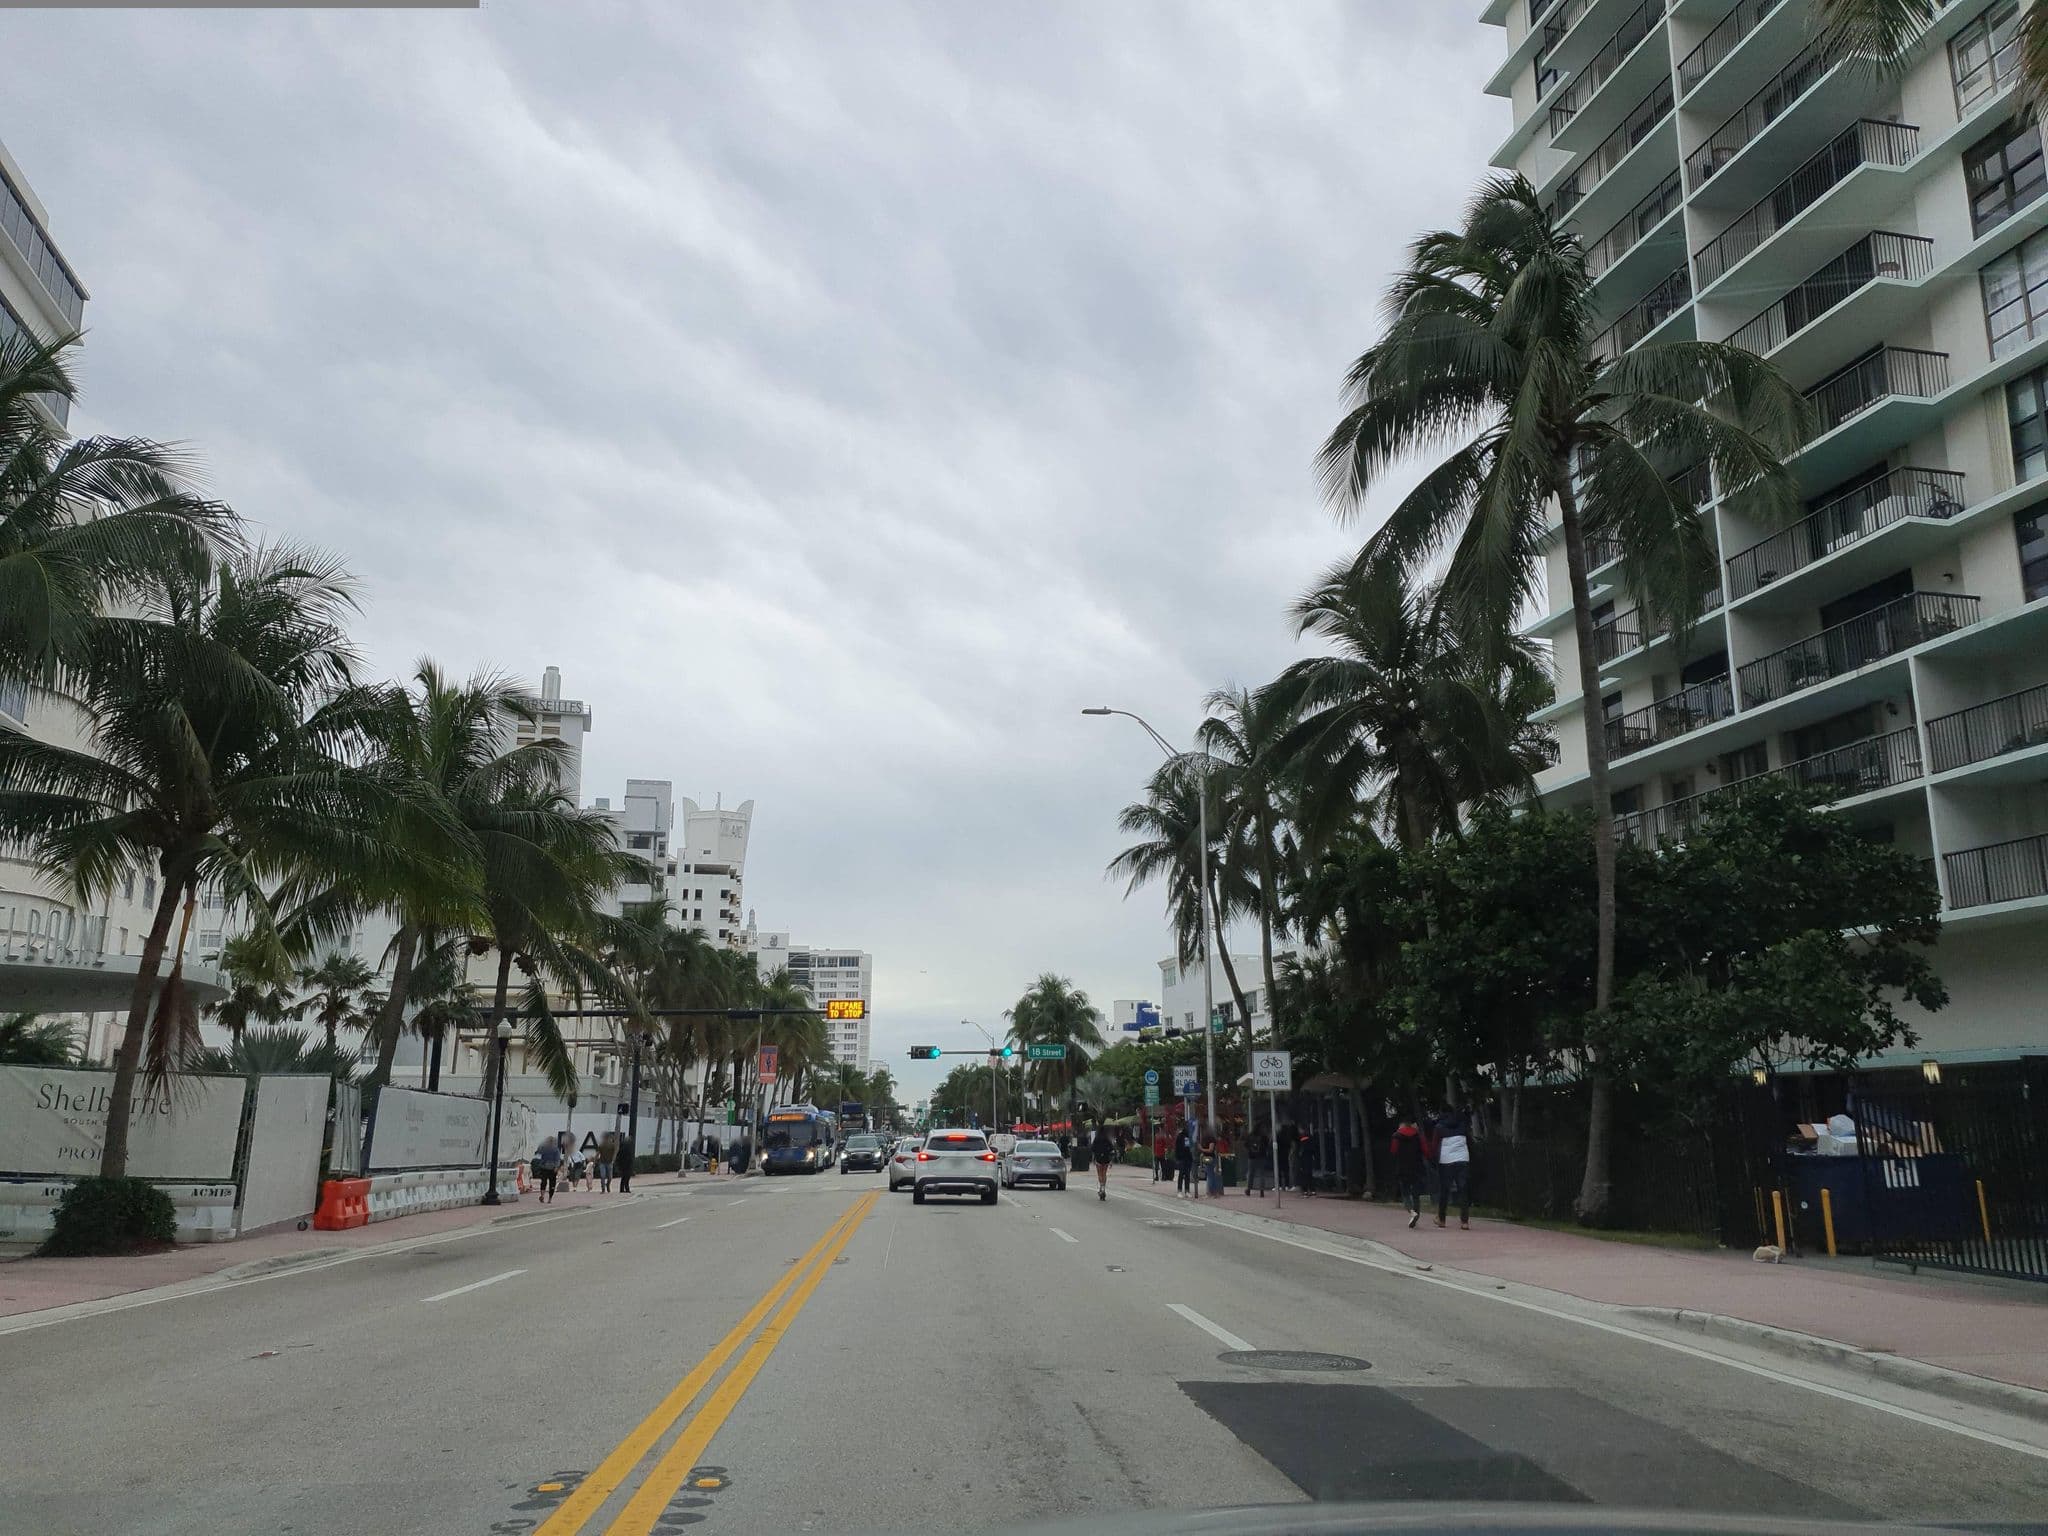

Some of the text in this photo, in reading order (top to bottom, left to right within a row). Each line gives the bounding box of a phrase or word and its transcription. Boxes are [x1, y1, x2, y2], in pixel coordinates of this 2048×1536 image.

[0, 905, 109, 966] LBORNE
[830, 1001, 863, 1010] PREPARE
[830, 1010, 862, 1018] TO STOP
[1042, 1048, 1062, 1056] Street
[37, 1083, 171, 1115] Shelbrne
